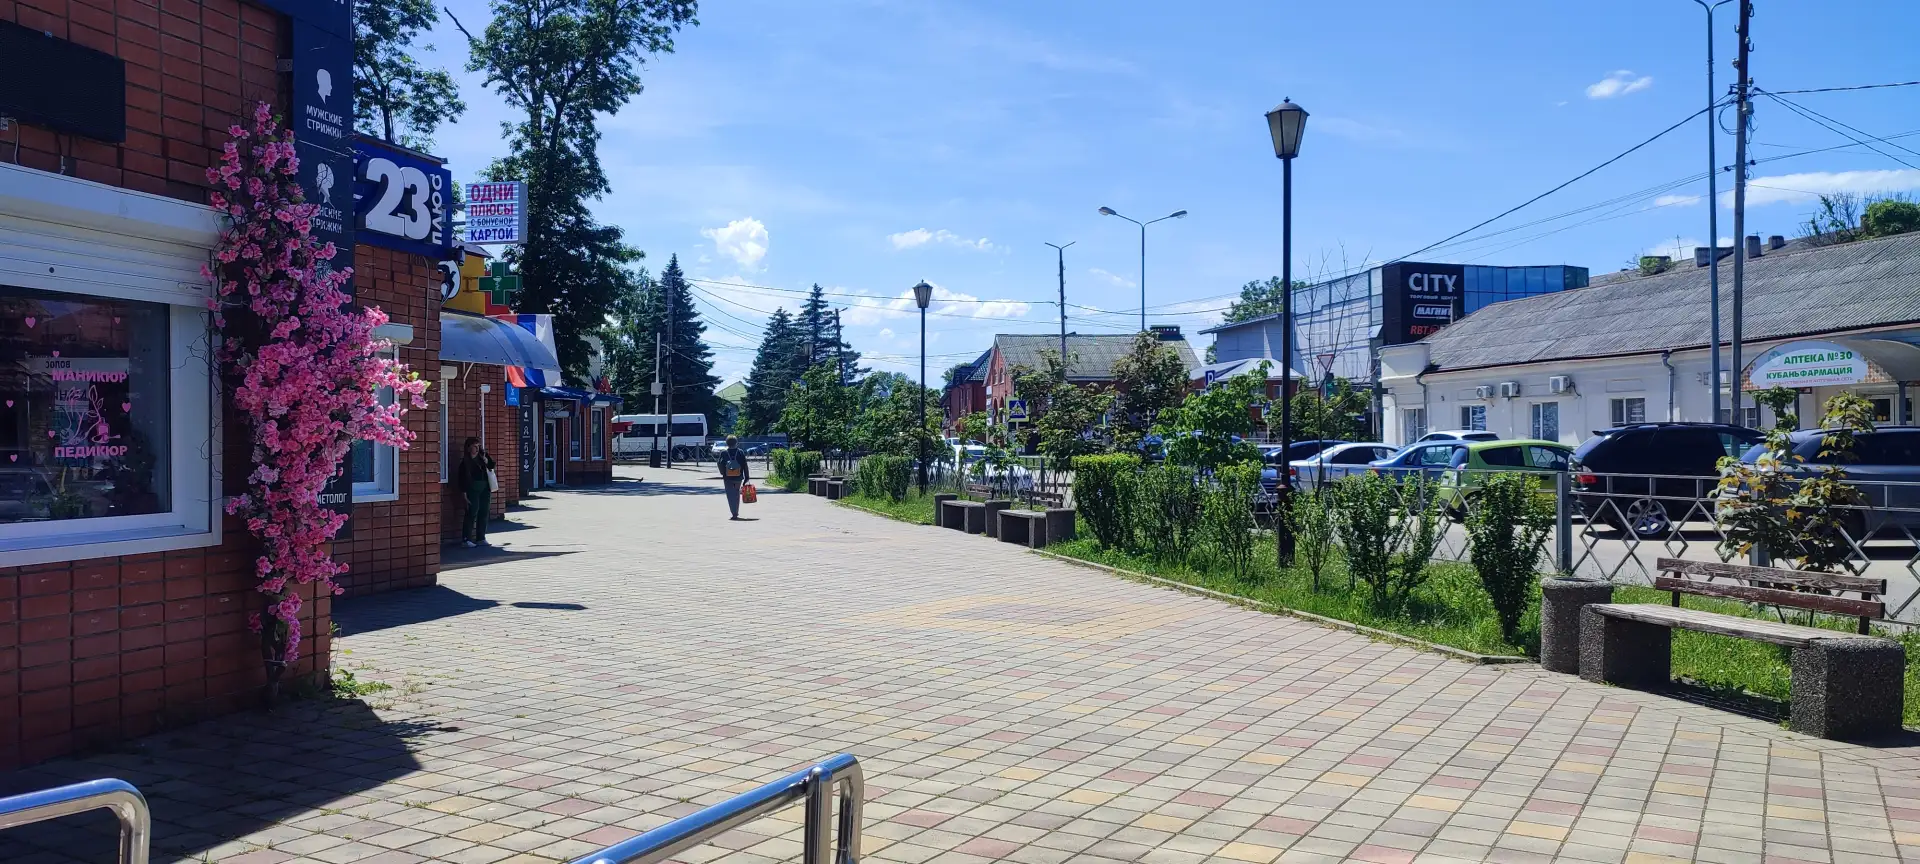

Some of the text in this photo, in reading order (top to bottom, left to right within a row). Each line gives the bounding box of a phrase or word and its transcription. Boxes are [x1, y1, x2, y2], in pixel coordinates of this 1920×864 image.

[306, 104, 343, 127] МУЖСКИЕ
[306, 118, 342, 139] СТРИЖКИ
[365, 157, 432, 240] 23
[470, 183, 514, 204] ОДНИ
[470, 203, 514, 217] ПЛЮСЫ
[470, 216, 513, 227] С БОНУСНОЙ
[470, 226, 513, 241] КАРТОЙ
[1408, 272, 1457, 292] CITY
[1783, 350, 1853, 364] АПТЕКА №30
[52, 371, 127, 382] МАНИКЮР
[1766, 366, 1853, 380] КУБАНЬФАРМАЦИЯ
[54, 445, 127, 458] ПЕДИКЮР
[316, 492, 347, 504] МЕТОЛОГ
